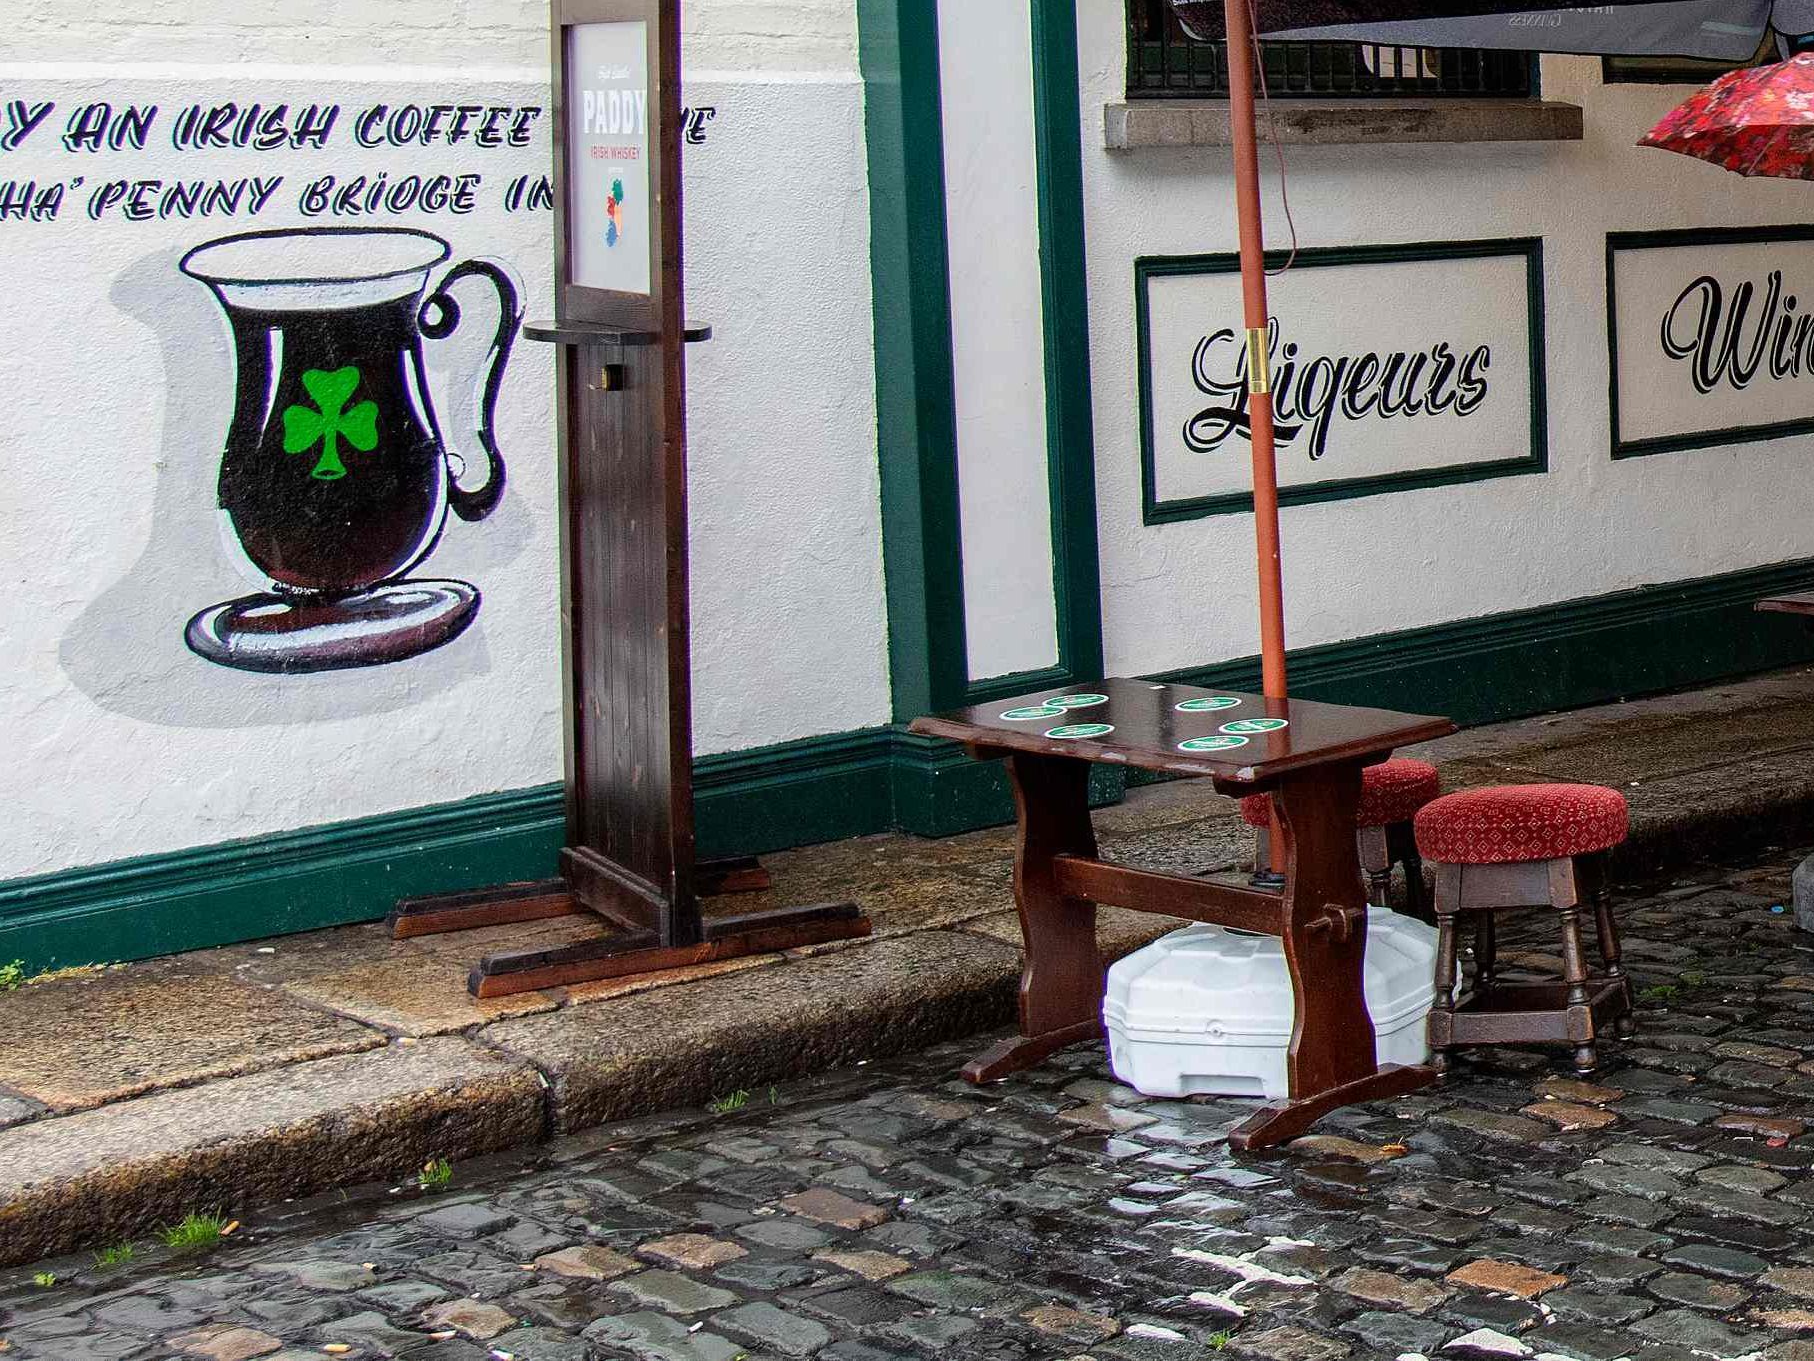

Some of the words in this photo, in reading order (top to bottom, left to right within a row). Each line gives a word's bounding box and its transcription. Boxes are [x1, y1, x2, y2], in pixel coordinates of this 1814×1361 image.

[63, 102, 157, 152] AN
[173, 101, 340, 150] IRISH
[355, 102, 547, 148] COFFEE
[583, 90, 647, 135] PADDY
